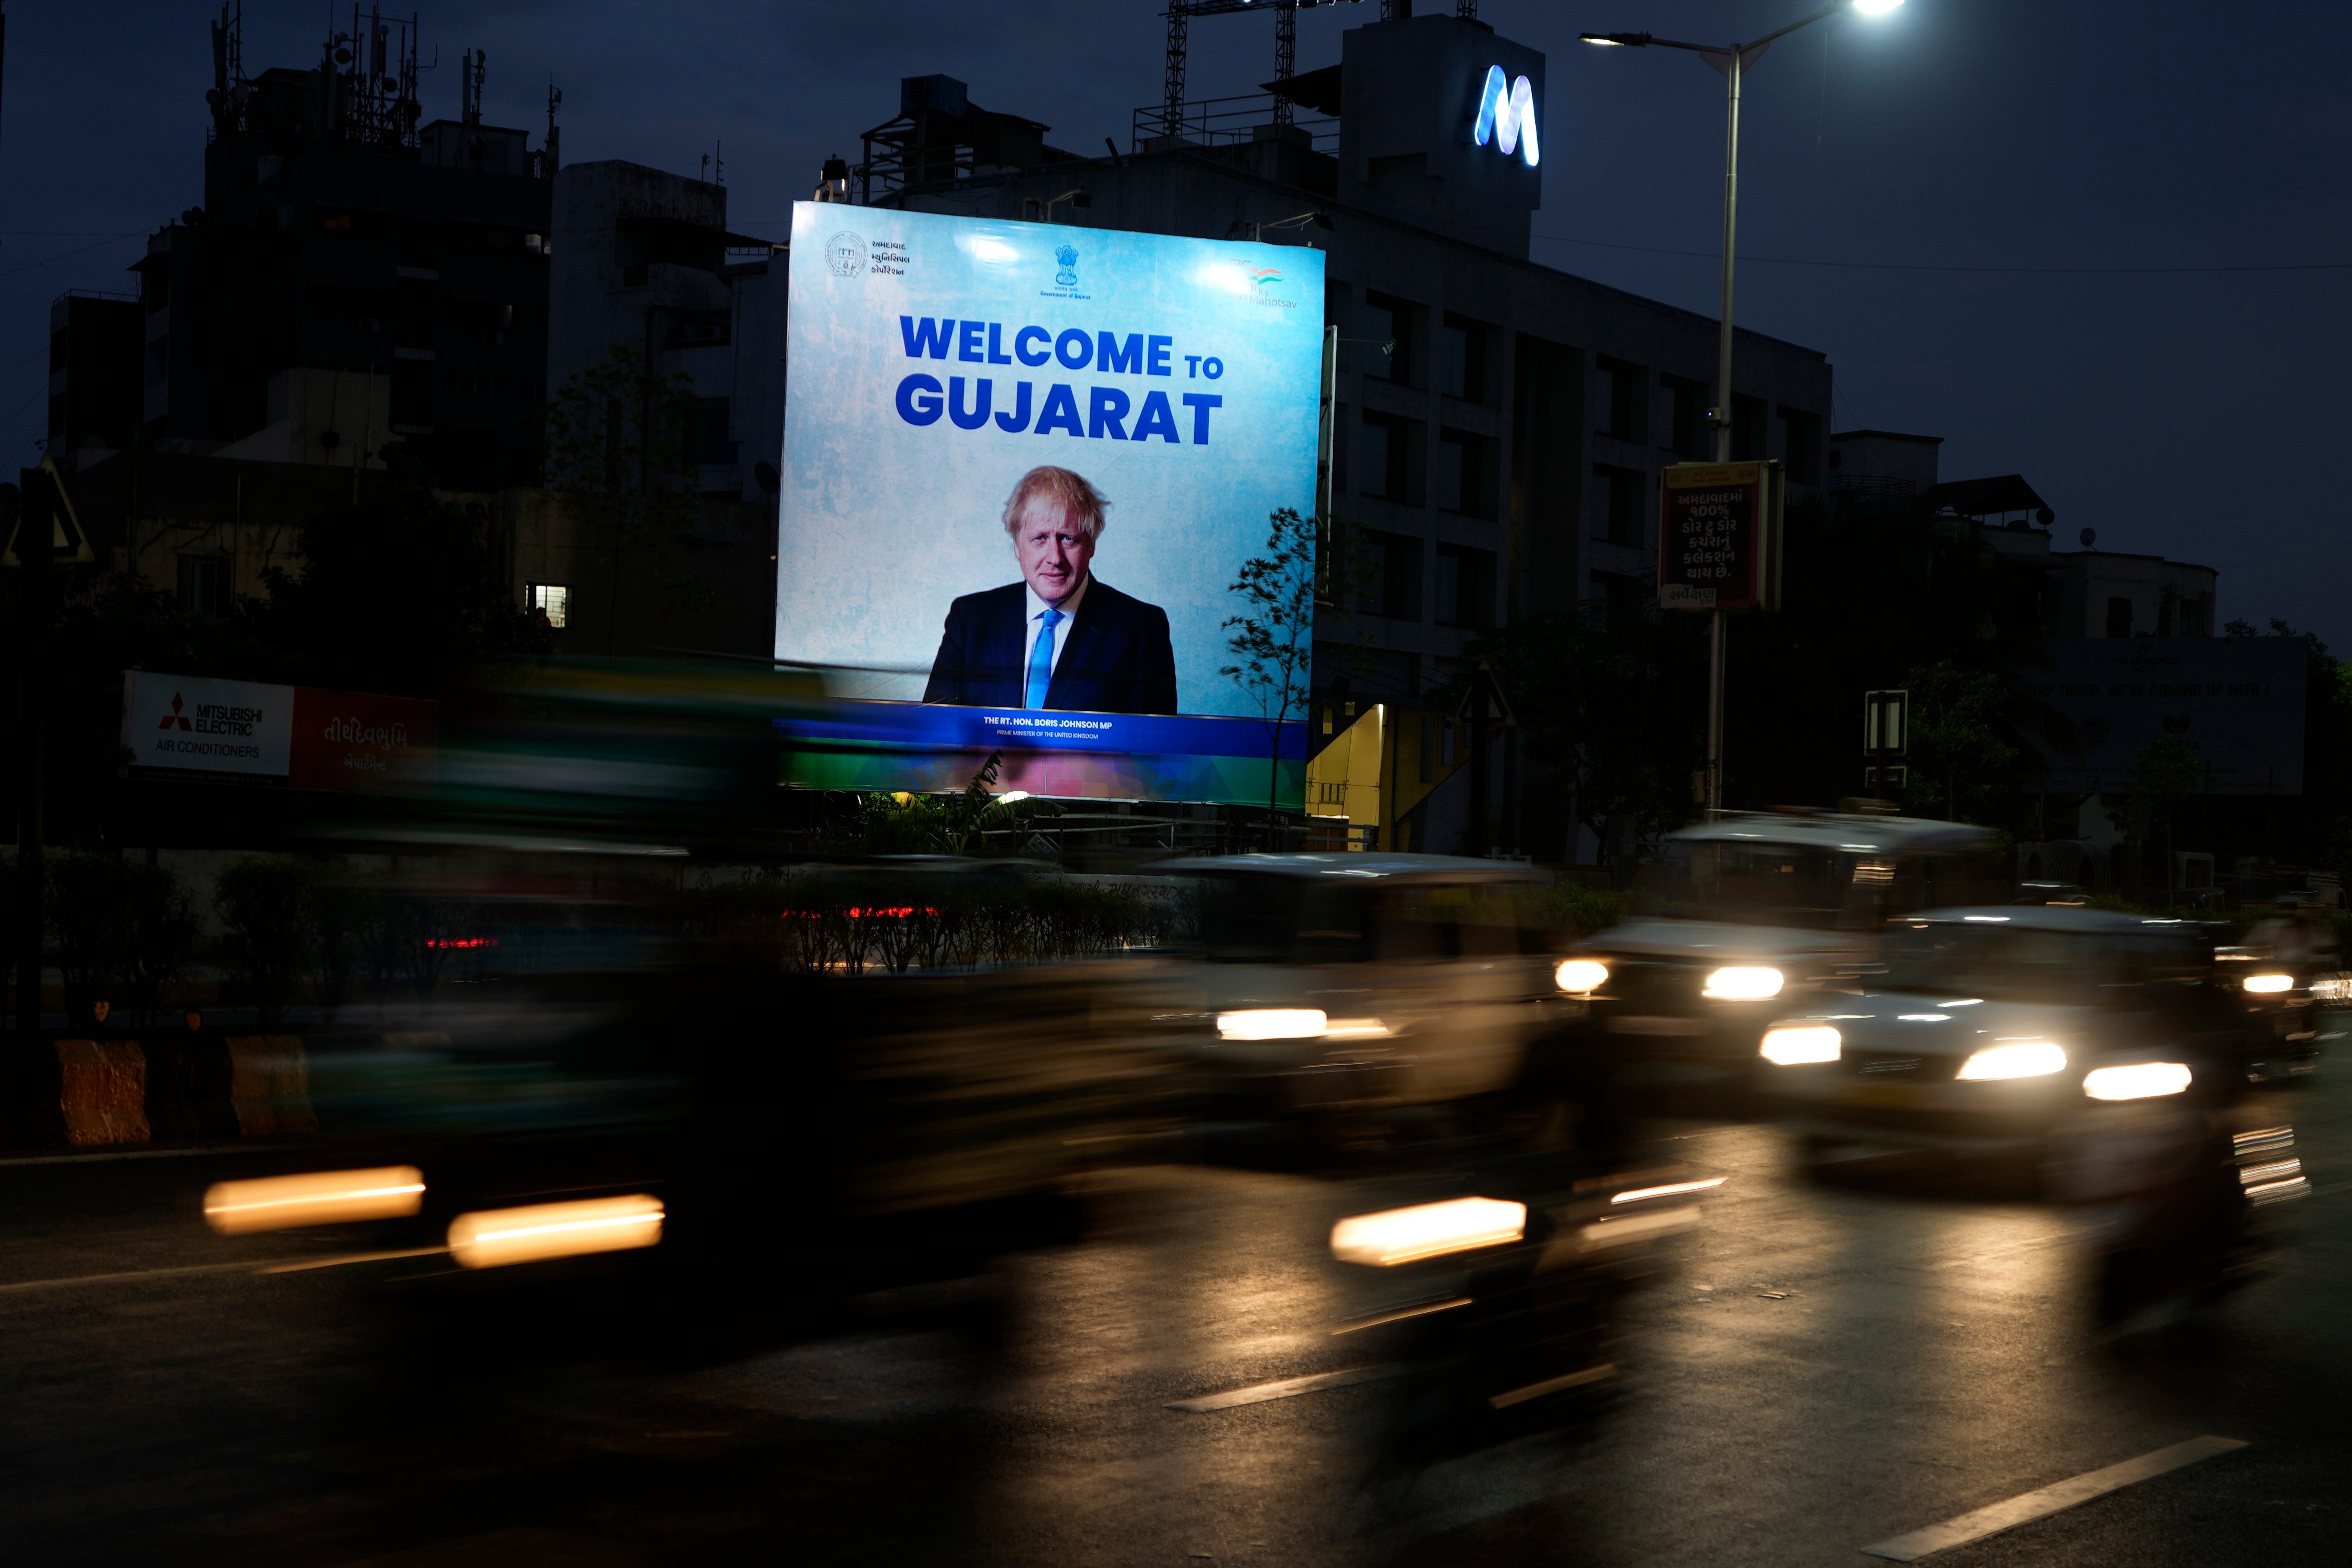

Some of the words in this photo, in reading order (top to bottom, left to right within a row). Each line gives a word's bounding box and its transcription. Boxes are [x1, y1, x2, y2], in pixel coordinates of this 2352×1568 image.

[872, 241, 906, 250] અમદાવાદ
[1250, 296, 1297, 308] Mahotsav
[900, 315, 1173, 376] WELCOME
[1184, 355, 1224, 379] TO
[896, 373, 1222, 445] GUJARAT
[1677, 489, 1743, 505] અમદાવાદમાં
[2149, 683, 2202, 697] COMING
[2207, 683, 2223, 696] UP
[2228, 683, 2260, 696] WITH
[197, 704, 262, 722] MITSUBISHI
[196, 719, 253, 736] ELECTRIC
[984, 716, 999, 724] THE
[1000, 717, 1012, 725] RT.
[1013, 717, 1033, 726] HON.
[1034, 718, 1058, 727] BORIS
[1059, 720, 1098, 729] JOHNSON
[156, 739, 174, 751] AIR
[178, 741, 259, 758] CONDITIONERS
